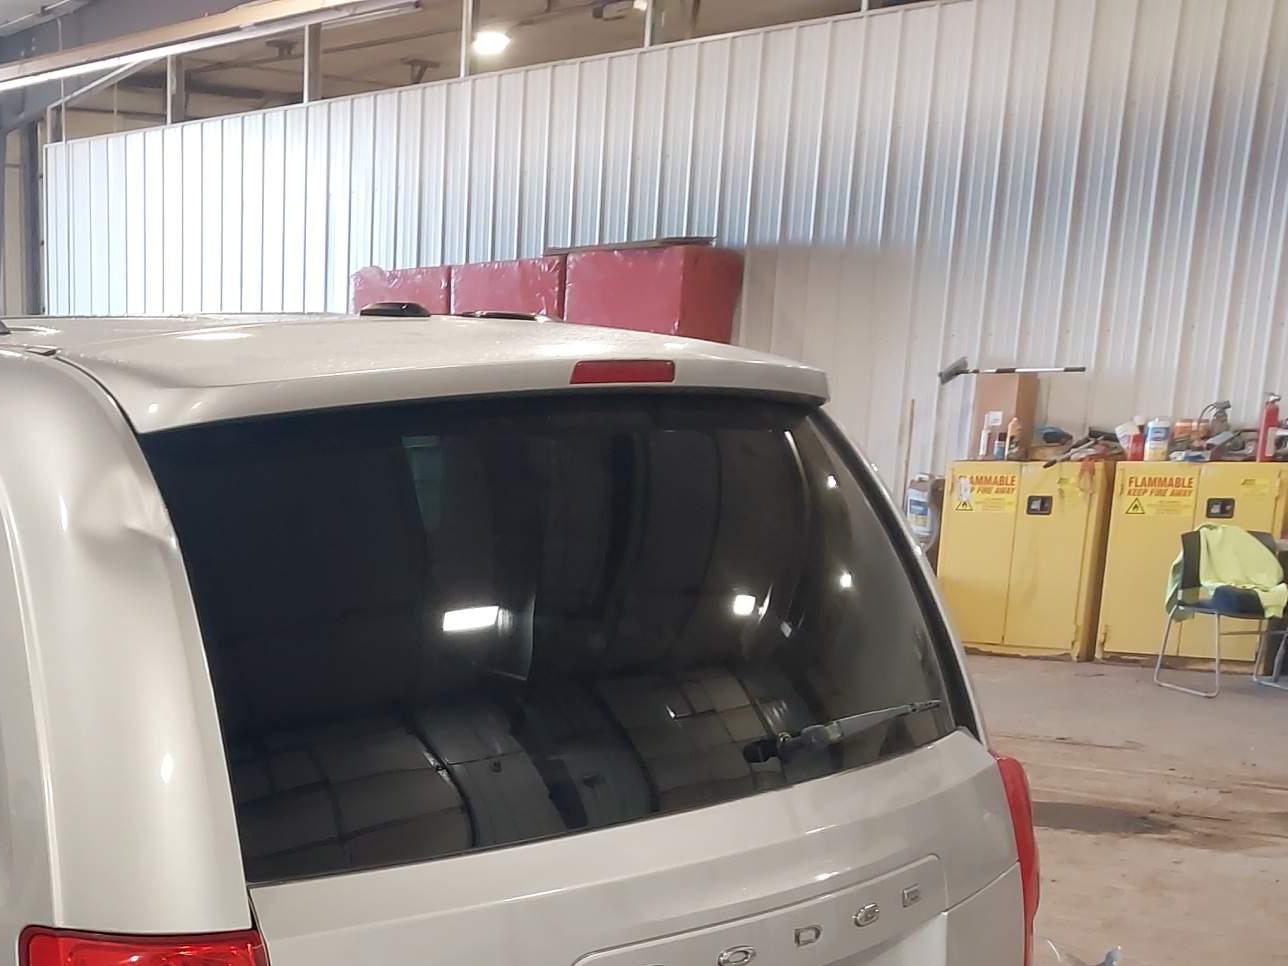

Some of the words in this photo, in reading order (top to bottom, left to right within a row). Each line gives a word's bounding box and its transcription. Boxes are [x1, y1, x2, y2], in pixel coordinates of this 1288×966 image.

[1128, 476, 1193, 488] FLAMMABLE
[1127, 488, 1148, 497] KEEP
[1149, 488, 1168, 497] FIRE
[1169, 488, 1192, 497] AWAY
